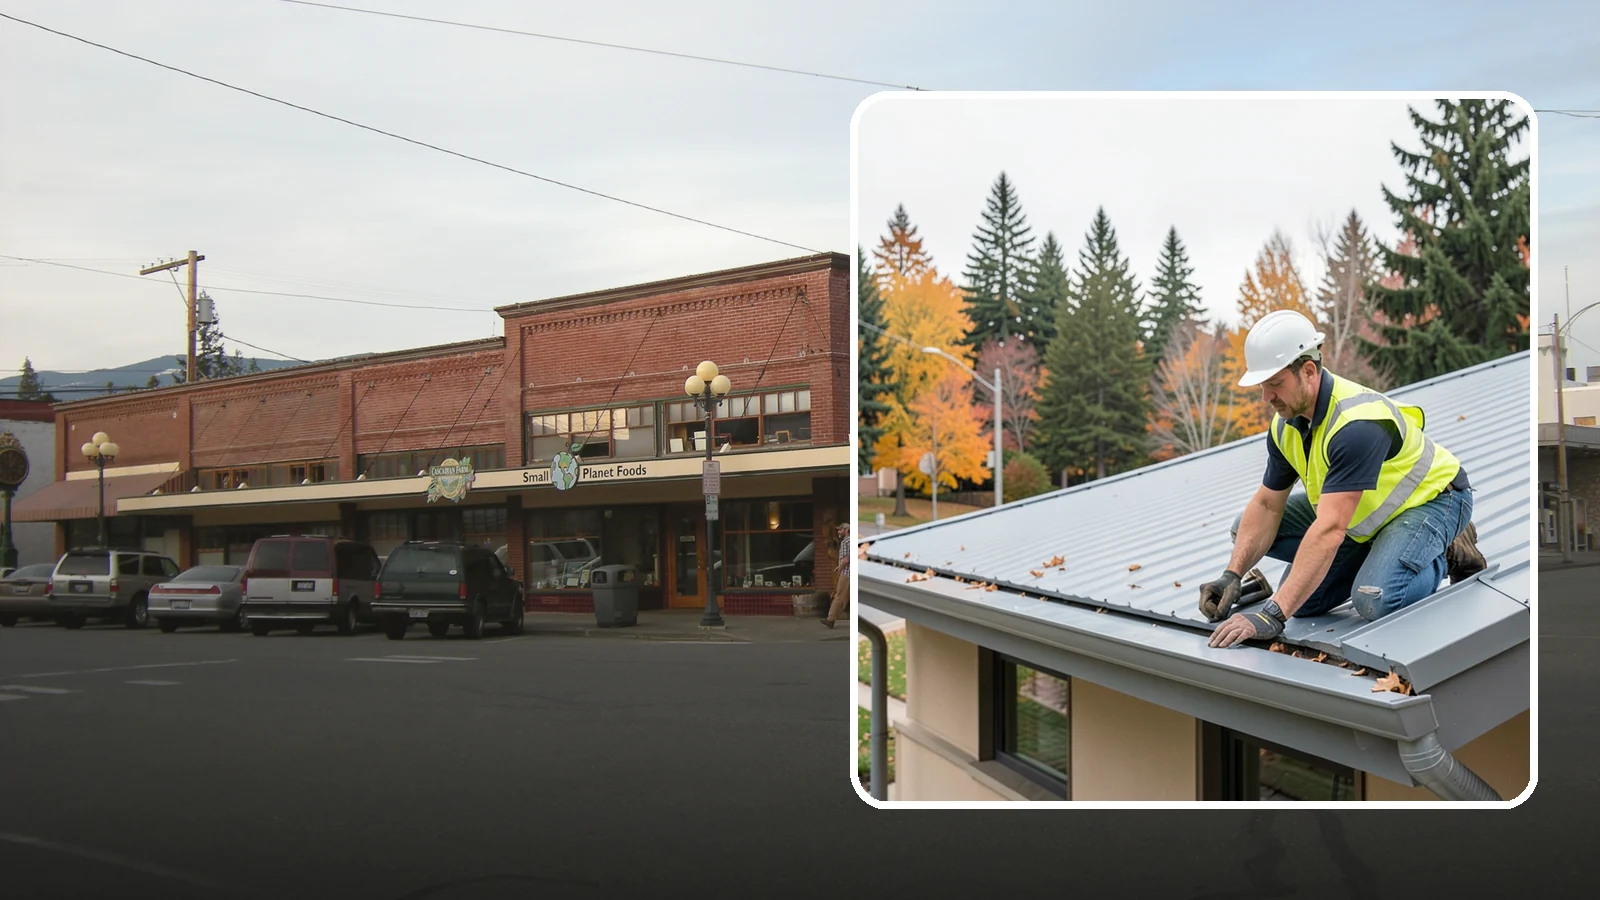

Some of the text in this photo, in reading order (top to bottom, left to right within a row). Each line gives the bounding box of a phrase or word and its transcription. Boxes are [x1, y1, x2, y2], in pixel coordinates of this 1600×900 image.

[523, 464, 647, 483] Small Planet Foods
